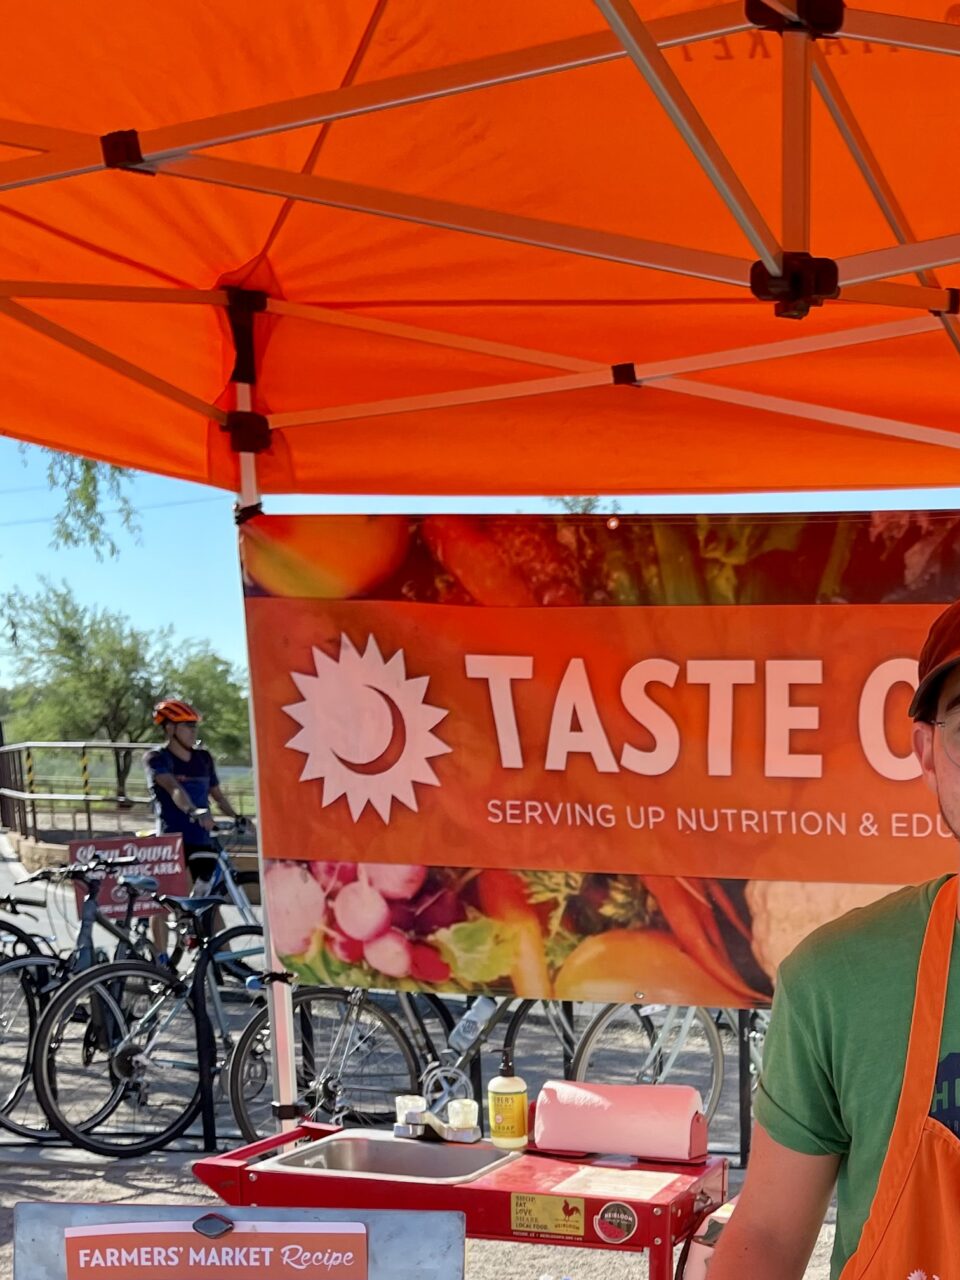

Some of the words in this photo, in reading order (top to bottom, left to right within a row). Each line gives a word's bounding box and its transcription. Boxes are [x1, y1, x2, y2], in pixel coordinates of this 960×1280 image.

[464, 654, 823, 778] TASTE
[858, 657, 923, 781] O
[486, 799, 615, 828] SERVING
[625, 805, 666, 829] UP
[676, 807, 847, 836] NUTRITION
[858, 811, 880, 837] &
[123, 837, 183, 863] Down!
[604, 1213, 633, 1222] HEIRLOOM
[188, 1247, 274, 1267] MARKET
[280, 1244, 355, 1270] Recipe
